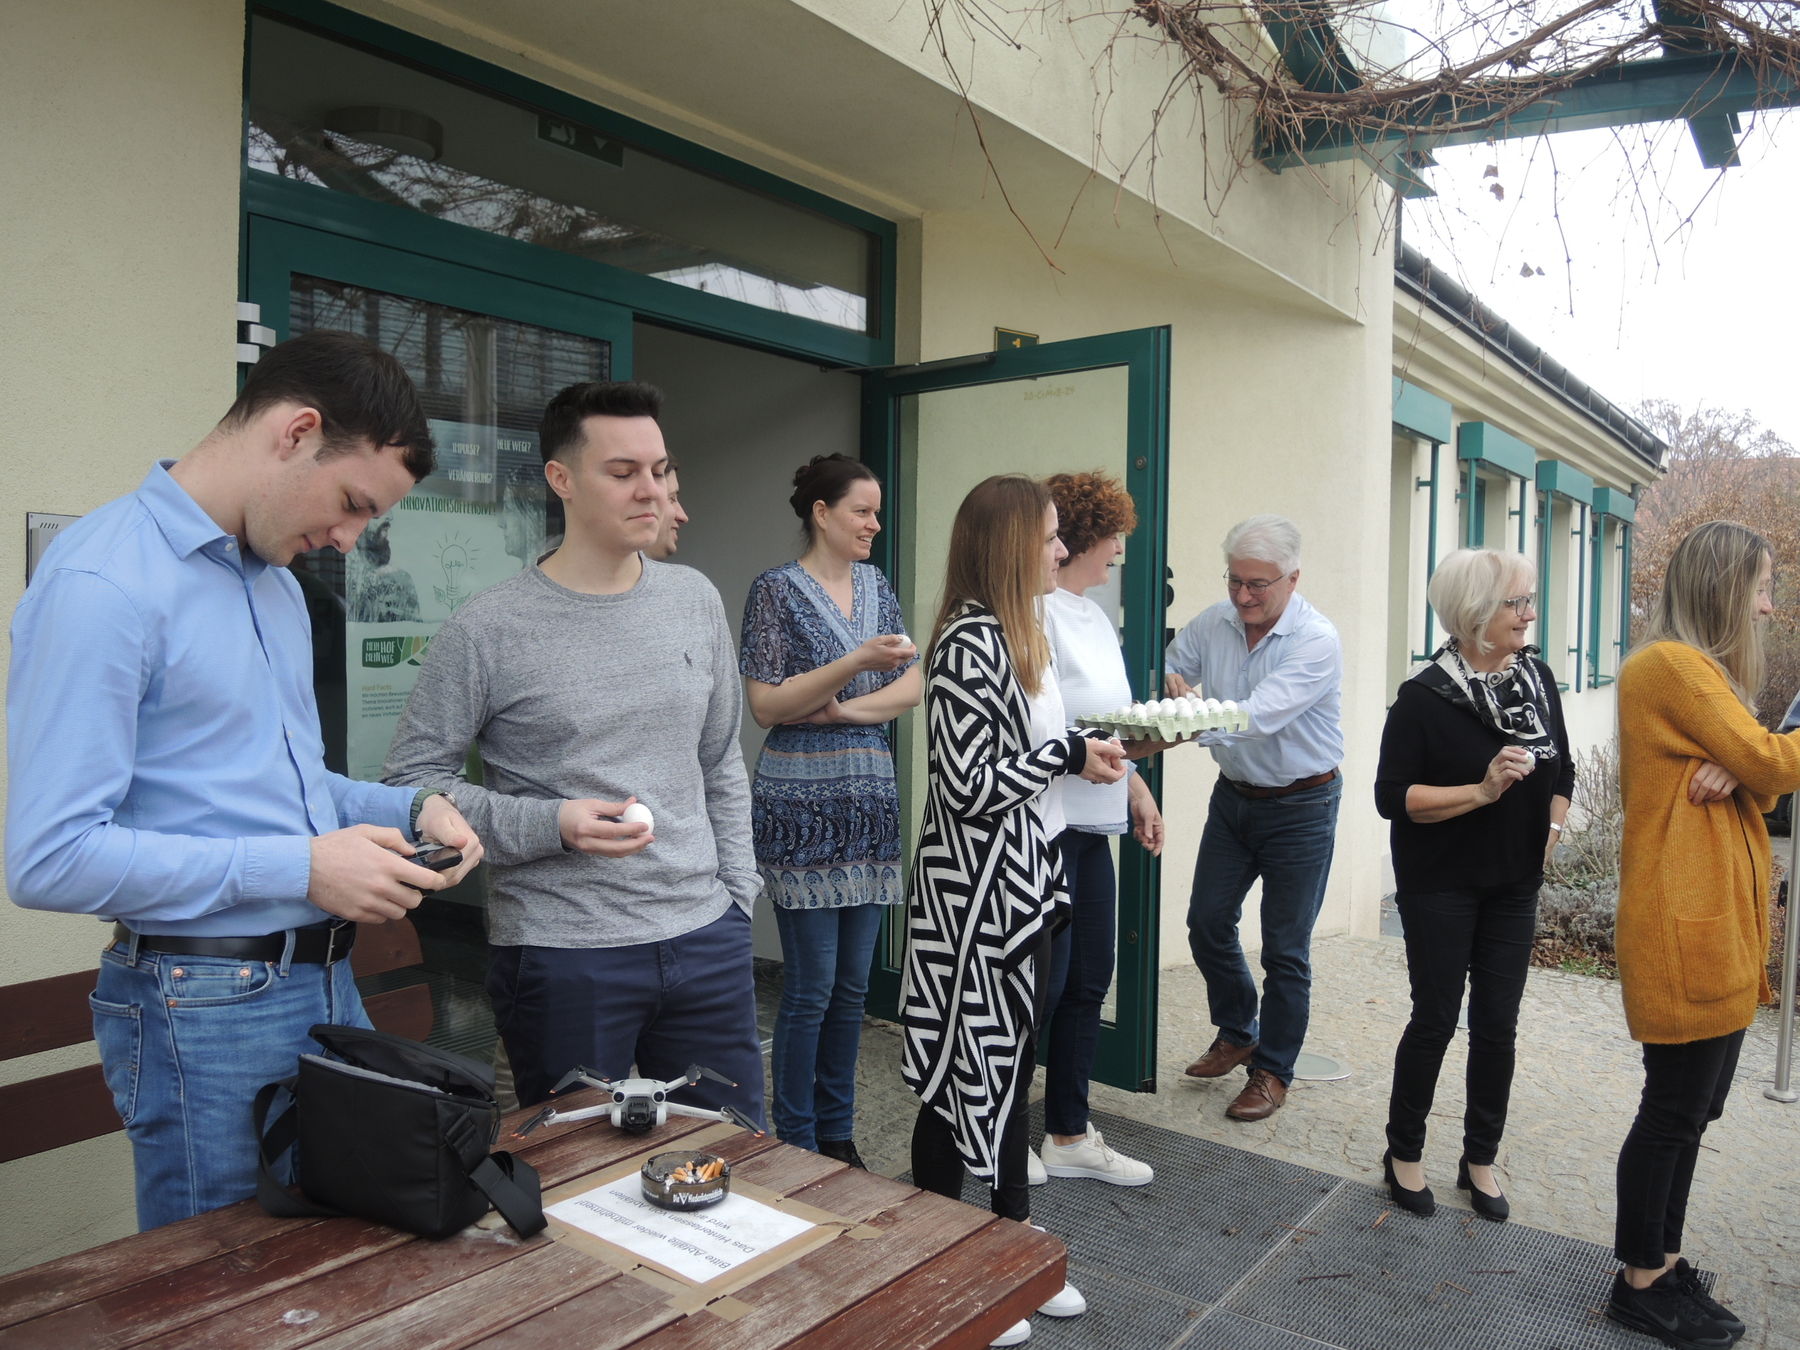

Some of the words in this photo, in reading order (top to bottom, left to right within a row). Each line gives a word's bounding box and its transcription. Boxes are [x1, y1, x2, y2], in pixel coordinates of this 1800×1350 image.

[380, 641, 396, 654] HOF
[380, 653, 395, 664] WEG
[574, 1200, 634, 1227] mitnehmen!
[632, 1224, 668, 1240] wieder
[668, 1214, 732, 1243] Hinterlassen
[731, 1241, 756, 1254] Das
[704, 1255, 732, 1269] Bitte
